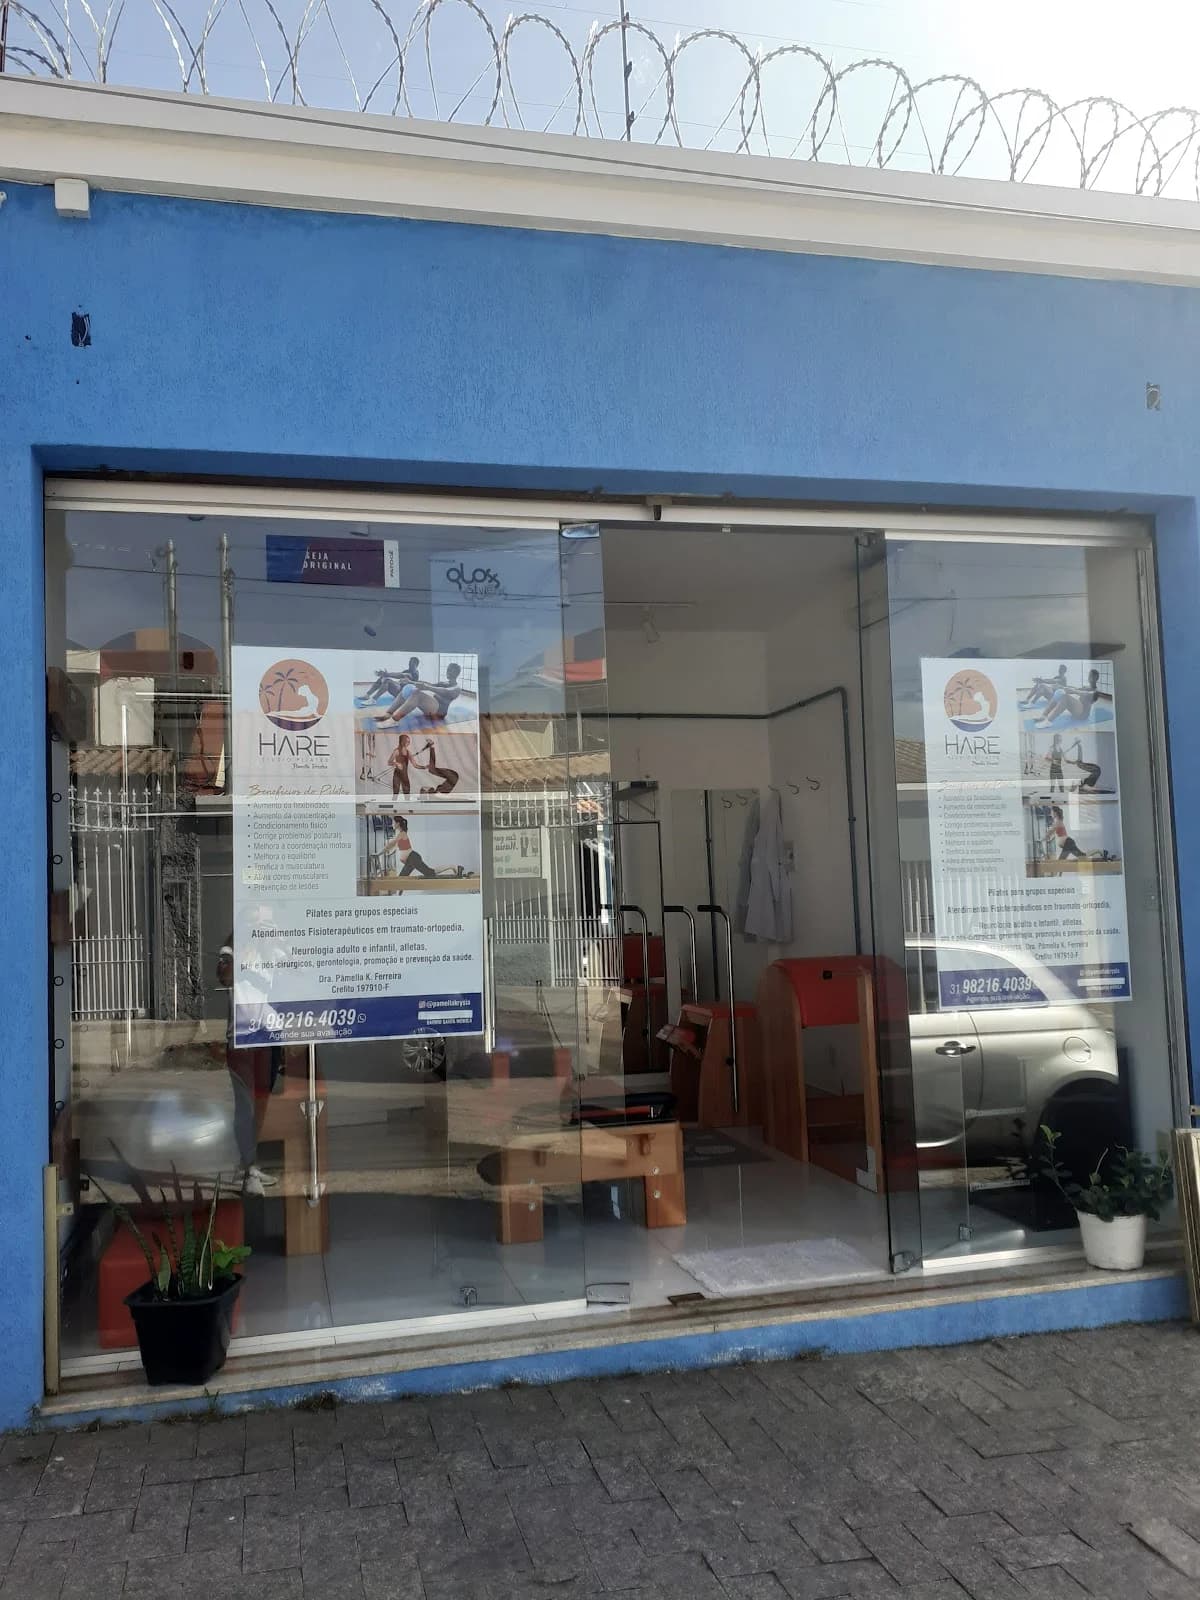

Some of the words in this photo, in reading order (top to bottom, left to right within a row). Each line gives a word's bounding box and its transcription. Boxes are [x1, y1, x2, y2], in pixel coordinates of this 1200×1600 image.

[304, 551, 329, 560] SEJA
[302, 560, 352, 570] ORIGINAL
[258, 732, 330, 756] HARE
[944, 734, 1001, 755] HARE
[305, 908, 332, 918] Pilates
[334, 909, 352, 919] para
[354, 907, 381, 918] grupos
[382, 906, 418, 917] especiais
[251, 928, 306, 939] Atendimentos
[376, 926, 389, 935] em
[291, 945, 334, 956] Neurologia
[336, 945, 360, 954] adulto
[316, 958, 362, 968] gerontologia,
[364, 956, 398, 966] promoção
[405, 954, 441, 965] prevenção
[442, 953, 451, 962] da
[318, 974, 334, 983] Dra.
[374, 971, 402, 981] Ferreira
[962, 975, 1032, 994] 98216.4039
[265, 1008, 357, 1030] 98216.4039
[300, 1030, 315, 1038] sua
